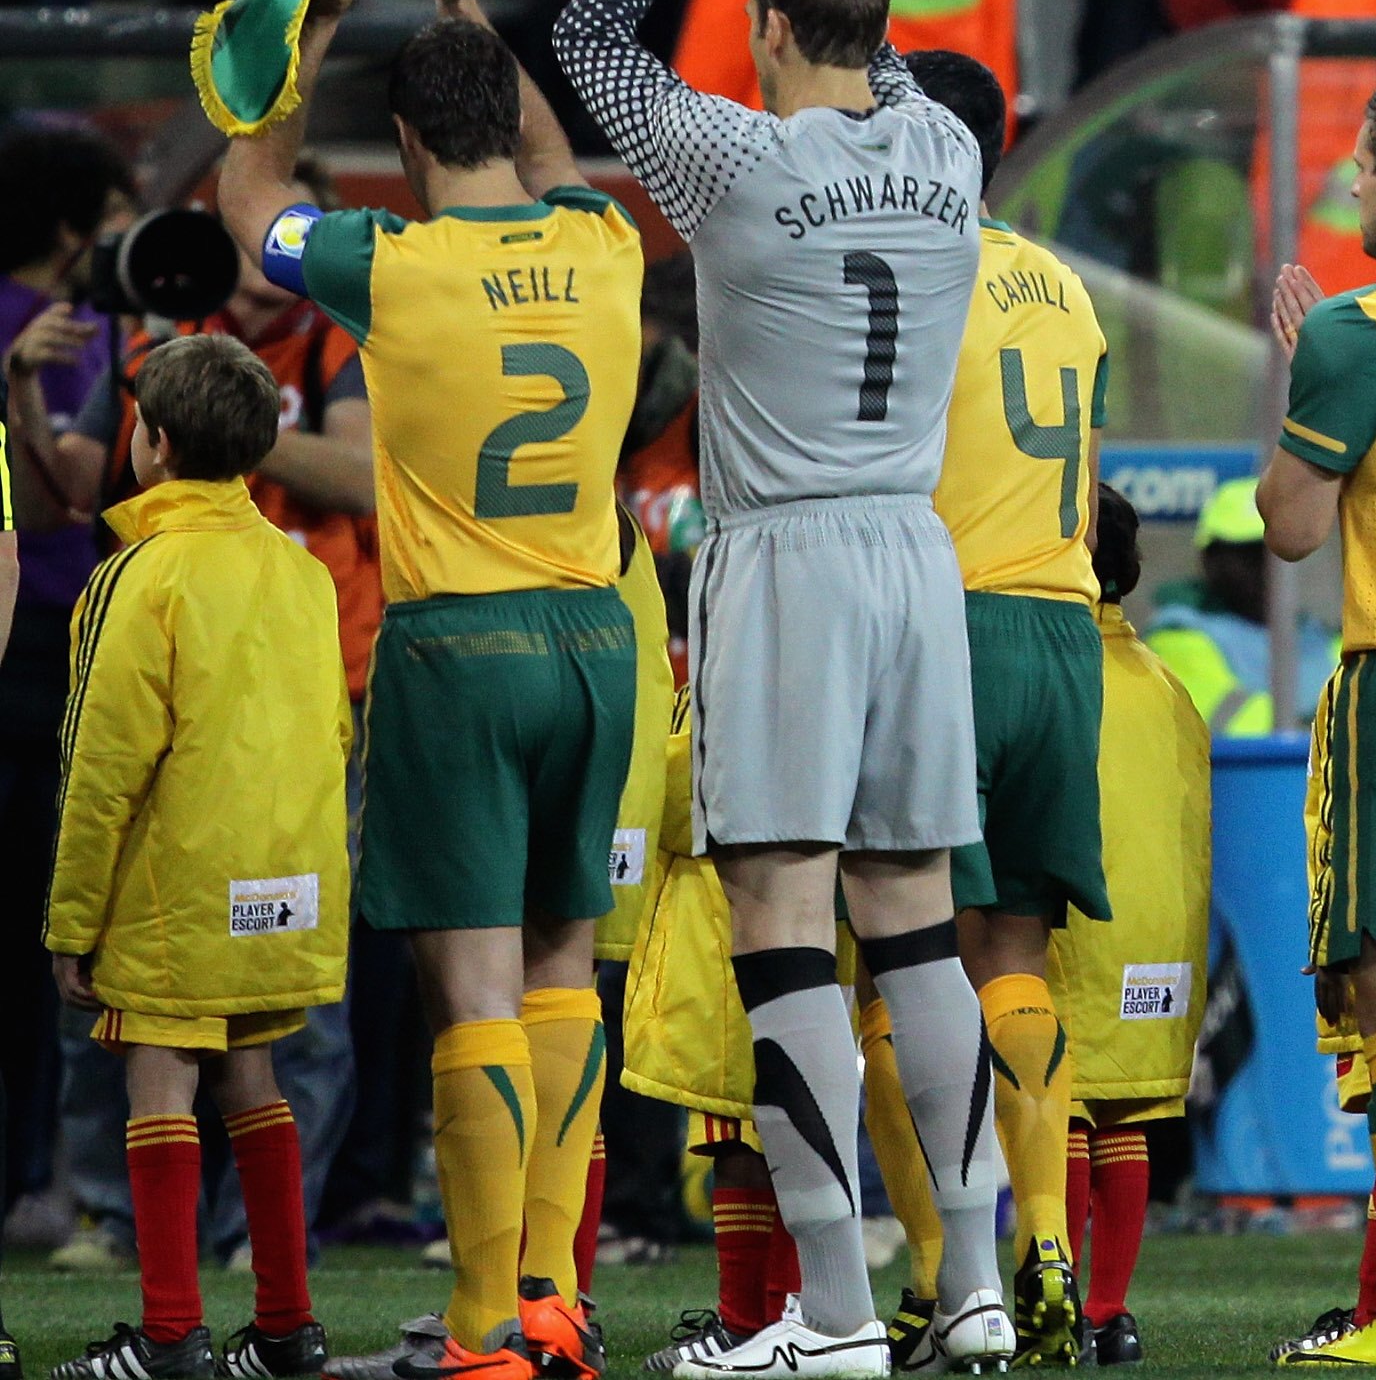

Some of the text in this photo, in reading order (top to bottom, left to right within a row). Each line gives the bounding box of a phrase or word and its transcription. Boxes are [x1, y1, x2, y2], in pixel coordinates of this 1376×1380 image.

[775, 173, 967, 241] SCHWARZER
[481, 266, 579, 310] NEILL
[986, 270, 1070, 313] CAHILL
[843, 249, 900, 422] 1
[475, 342, 591, 518] 2
[1000, 348, 1081, 539] 4
[231, 916, 275, 931] ESCORT
[232, 902, 275, 918] PLAYER
[1122, 1000, 1161, 1015] ESCORT
[1124, 986, 1161, 1000] PLAYER
